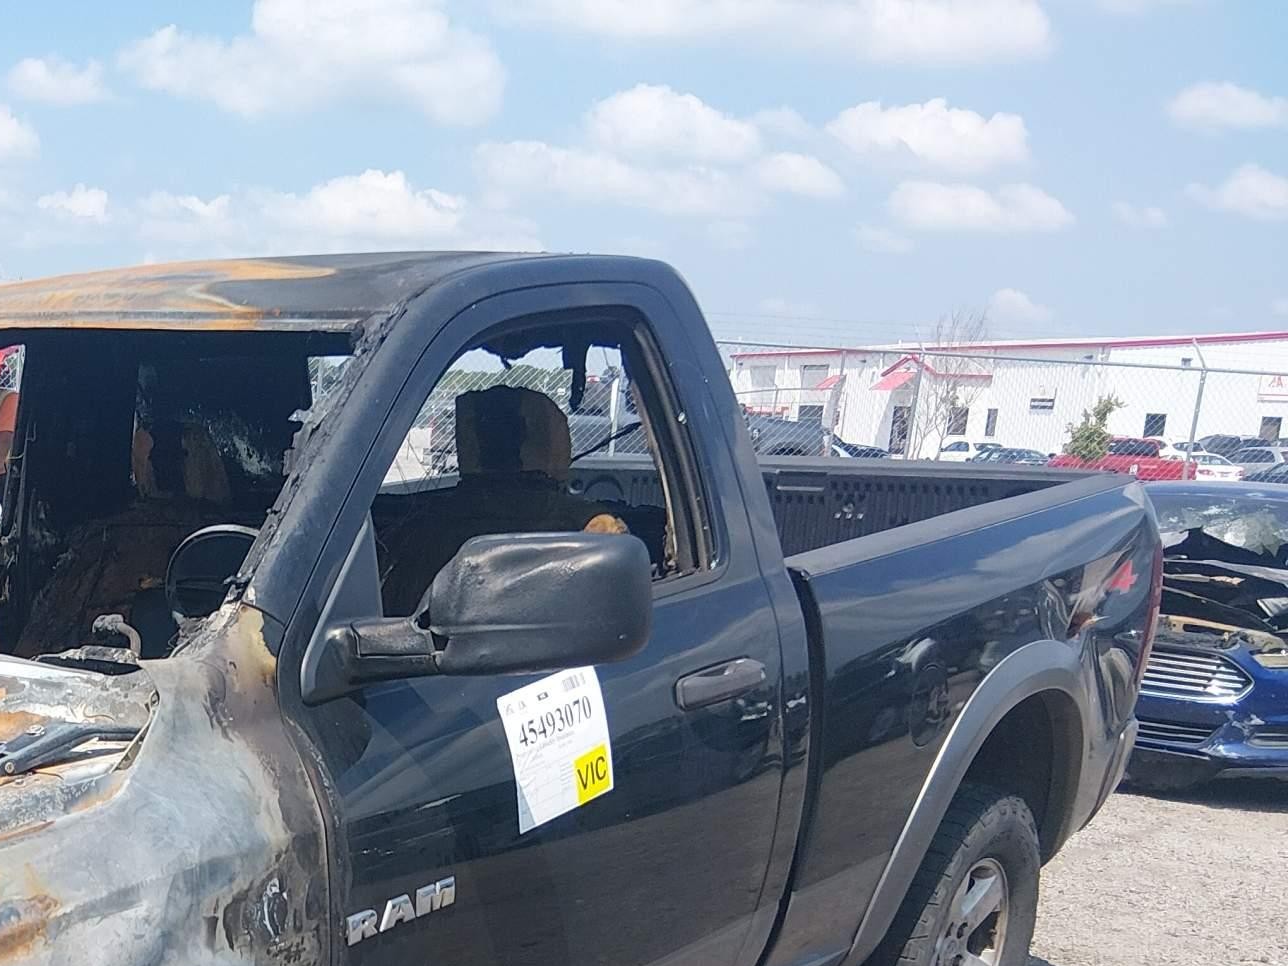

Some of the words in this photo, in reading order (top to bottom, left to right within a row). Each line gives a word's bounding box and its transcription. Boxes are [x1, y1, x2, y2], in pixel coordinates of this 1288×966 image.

[519, 695, 592, 746] 45493070
[577, 757, 607, 790] VIC
[345, 875, 456, 947] RAM
